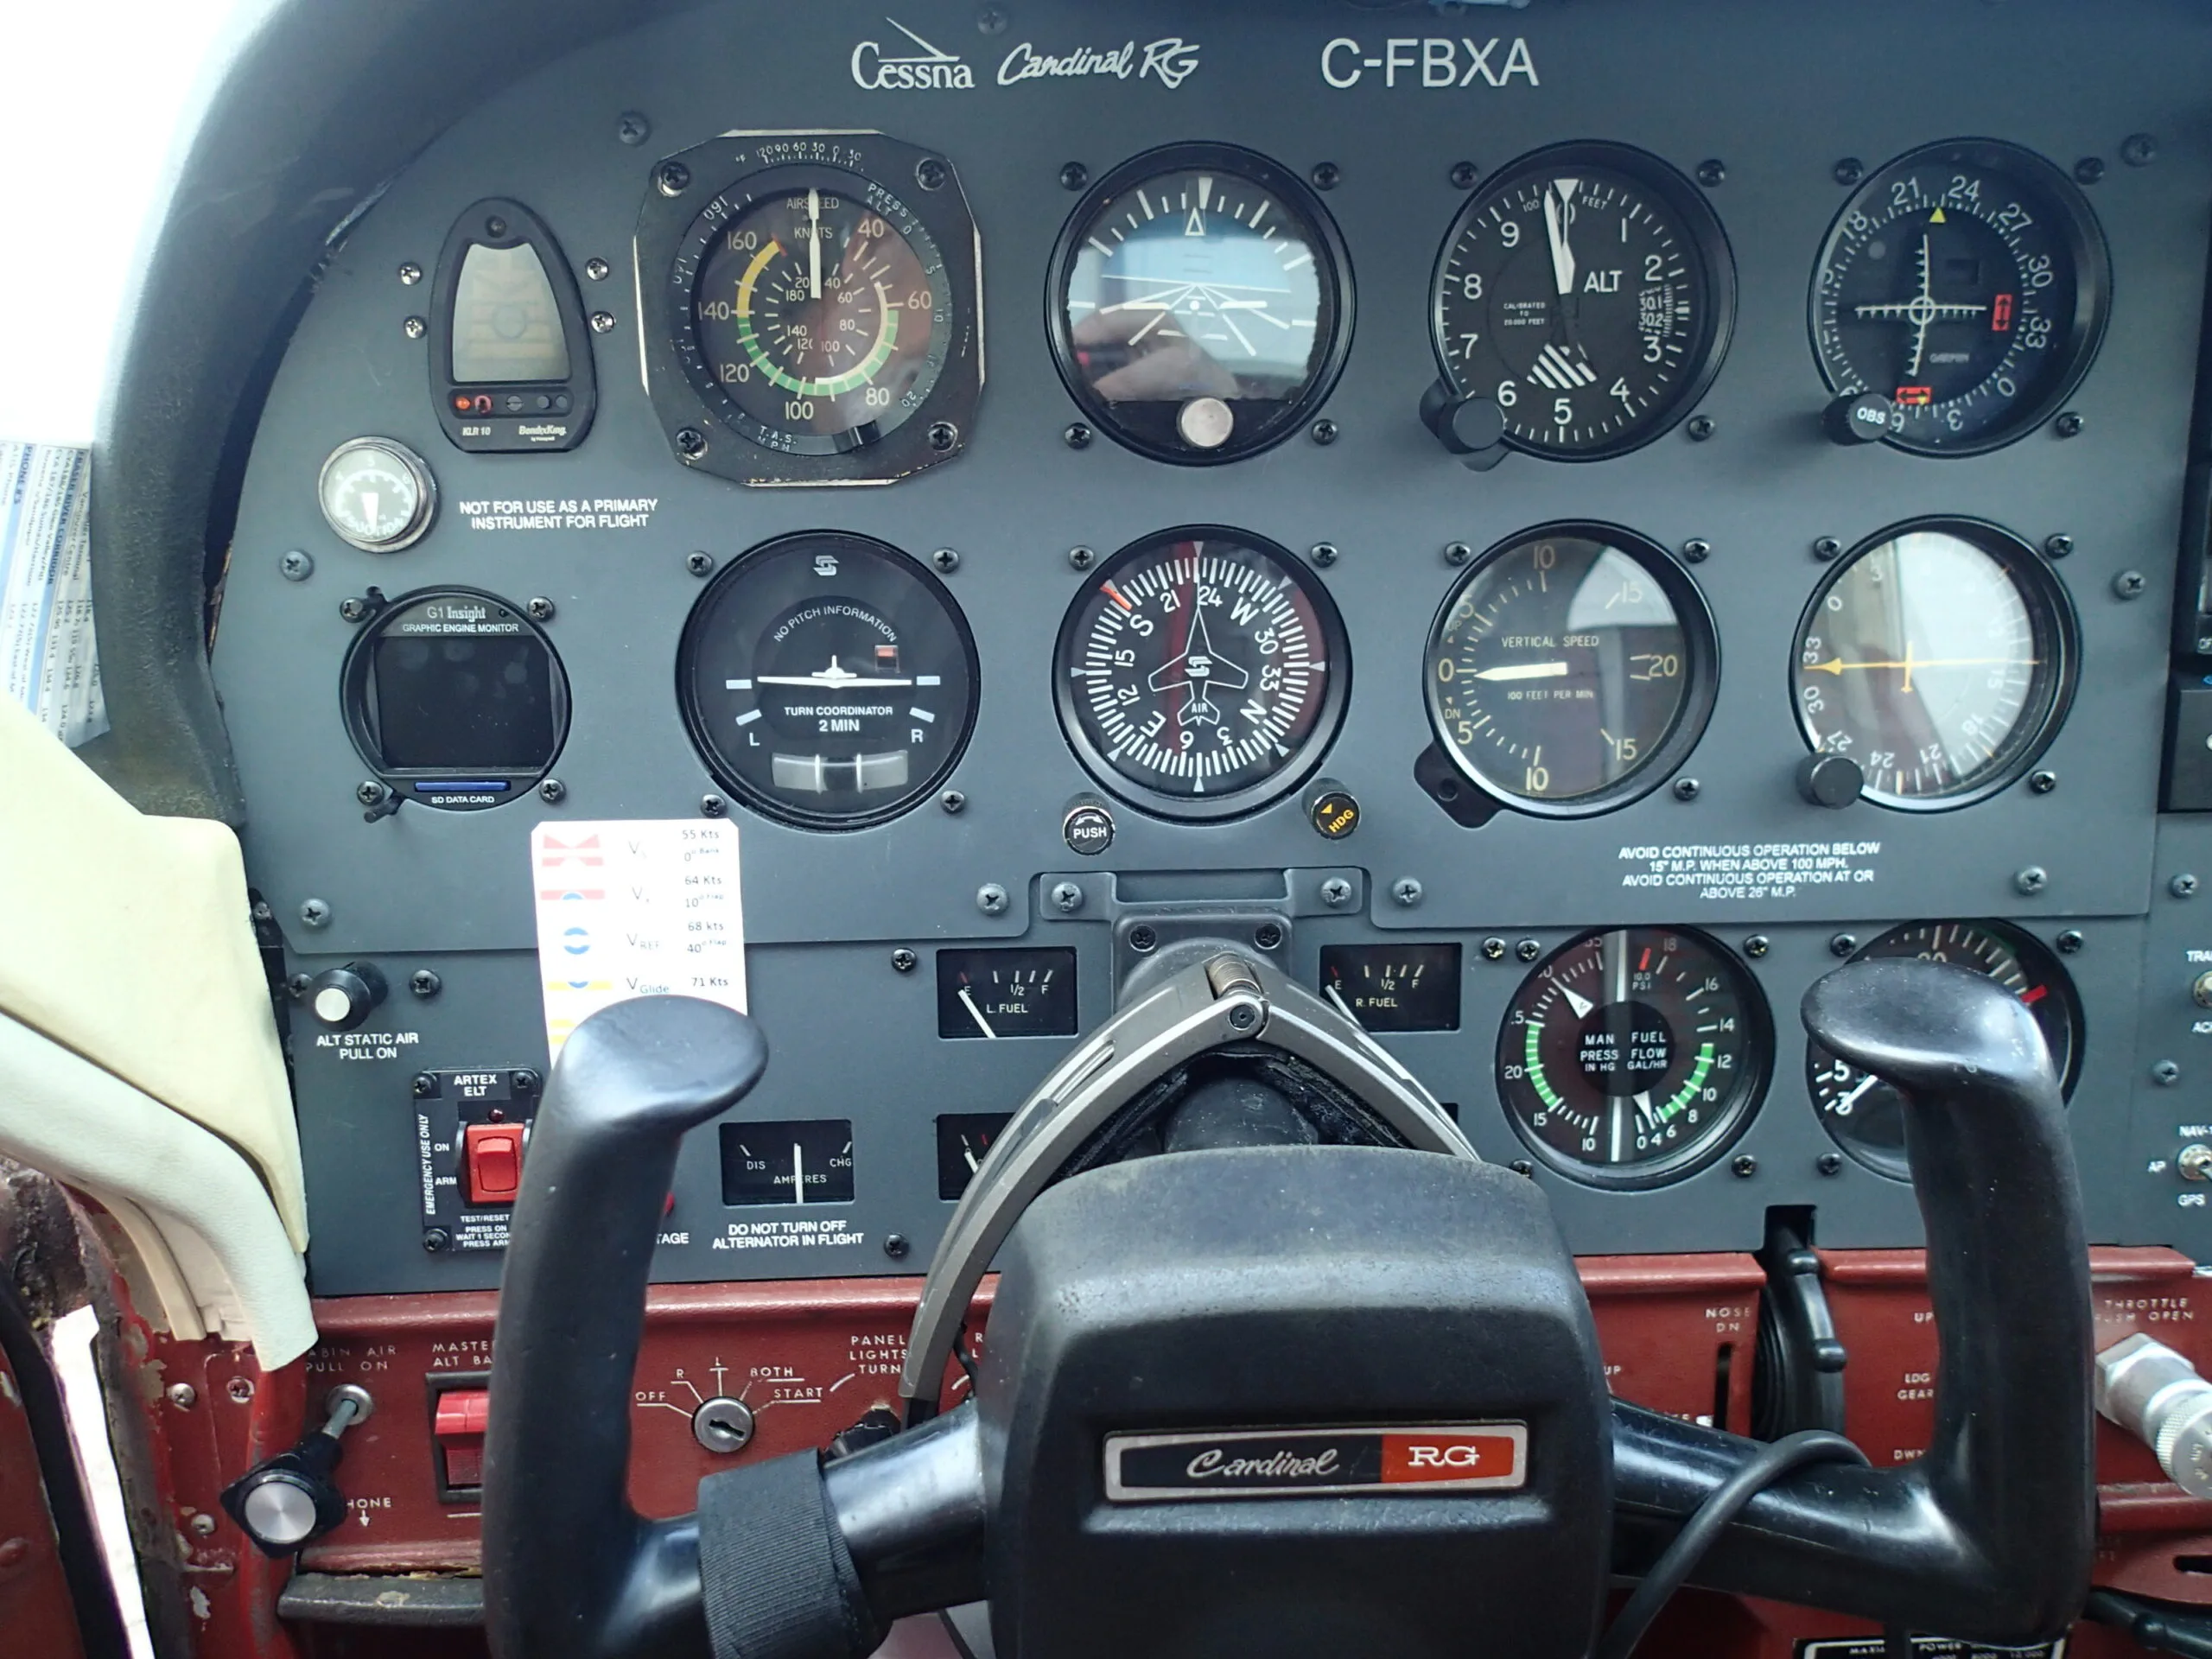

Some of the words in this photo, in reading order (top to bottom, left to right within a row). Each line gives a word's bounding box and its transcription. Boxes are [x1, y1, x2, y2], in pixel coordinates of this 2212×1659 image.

[851, 41, 976, 89] Cessna
[996, 37, 1135, 88] Cardinal
[1141, 39, 1199, 88] RG
[1320, 38, 1540, 88] C-FBXA
[1891, 177, 1920, 205] 21
[1948, 176, 1980, 201] 24
[1582, 195, 1607, 211] FEET
[857, 219, 883, 237] 40
[1501, 221, 1519, 247] 9
[728, 232, 756, 250] 160
[1645, 255, 1662, 281] 2
[2029, 256, 2053, 288] 30
[1464, 273, 1482, 299] 8
[1584, 270, 1623, 292] ALT
[908, 292, 931, 309] 60
[698, 302, 729, 320] 140
[1460, 334, 1478, 359] 7
[1644, 336, 1661, 362] 3
[720, 365, 748, 382] 120
[866, 387, 889, 405] 80
[1498, 380, 1516, 406] 6
[1610, 377, 1630, 403] 4
[785, 401, 813, 420] 100
[1554, 398, 1572, 424] 5
[1857, 407, 1885, 424] OBS
[460, 501, 490, 515] NOT
[494, 500, 522, 514] FOR
[524, 500, 555, 513] USE
[558, 499, 578, 513] AS
[581, 499, 591, 512] A
[595, 499, 658, 512] PRIMARY
[471, 516, 563, 530] INSTRUMENT
[567, 516, 595, 528] FOR
[600, 514, 649, 527] FLIGHT
[1160, 590, 1180, 613] 21
[1198, 587, 1223, 607] 24
[427, 608, 444, 618] G1
[448, 607, 486, 622] Insight
[1230, 598, 1259, 626] W
[403, 624, 442, 632] GRAPHIC
[774, 626, 790, 642] NO
[788, 607, 821, 628] PITCH
[823, 606, 898, 642] INFORMATION
[1130, 614, 1154, 636] S
[1255, 628, 1279, 654] 30
[1502, 637, 1555, 648] VERTICAL
[1563, 637, 1599, 646] SPEED
[1115, 650, 1135, 666] 15
[1649, 656, 1677, 677] 20
[785, 707, 814, 715] TURN
[817, 707, 893, 715] COORDINATOR
[1192, 703, 1208, 713] AIR
[1240, 699, 1267, 724] N
[819, 721, 828, 731] 2
[831, 721, 860, 732] MIN
[1140, 711, 1166, 738] E
[749, 734, 760, 746] L
[911, 729, 923, 742] R
[1616, 739, 1637, 760] 15
[1526, 767, 1548, 791] 10
[1329, 810, 1354, 832] HDG
[1073, 827, 1107, 839] PUSH
[1618, 847, 1658, 859] AVOID
[1662, 846, 1749, 858] CONTINUOUS
[1753, 844, 1829, 856] OPERATION
[1833, 842, 1880, 855] BELOW
[1671, 861, 1697, 871] M.P.
[1700, 860, 1740, 870] WHEN
[1742, 859, 1787, 870] ABOVE
[1792, 858, 1812, 869] 100
[1815, 858, 1848, 869] MPH.
[685, 876, 698, 885] 64
[704, 876, 721, 885] Kts
[1622, 874, 1662, 887] AVOID
[1666, 874, 1752, 885] CONTINUOUS
[1757, 872, 1832, 883] OPERATION
[1834, 871, 1850, 882] AT
[1853, 870, 1873, 881] OR
[1700, 887, 1745, 899] ABOVE
[1771, 887, 1796, 898] M.P.
[688, 922, 702, 931] 68
[707, 922, 723, 931] kts
[640, 984, 669, 994] Glide
[1705, 979, 1718, 991] 16
[1000, 1004, 1028, 1014] FUEL
[1370, 997, 1397, 1007] FUEL
[317, 1035, 340, 1046] ALT
[345, 1034, 392, 1045] STATIC
[396, 1033, 418, 1044] AIR
[1586, 1035, 1615, 1045] MAN
[1631, 1032, 1667, 1043] FUEL
[340, 1048, 373, 1058] PULL
[376, 1048, 397, 1058] ON
[1580, 1051, 1618, 1060] PRESS
[1631, 1048, 1667, 1058] FLOW
[1504, 1066, 1522, 1078] 20
[1586, 1063, 1596, 1071] IN
[1627, 1059, 1667, 1070] GAL/HR
[454, 1075, 497, 1085] ARTEX
[464, 1087, 486, 1096] ELT
[419, 1114, 429, 1138] ONLY
[421, 1140, 431, 1160] USE
[747, 1161, 766, 1170] DIS
[830, 1158, 851, 1167] CHG
[2148, 1161, 2165, 1173] AP
[421, 1161, 435, 1215] EMERGENCY
[2178, 1195, 2205, 1206] GPS
[461, 1214, 509, 1223] TEST/RESET
[729, 1224, 748, 1235] DO
[752, 1223, 779, 1233] NOT
[781, 1222, 817, 1232] TURN
[820, 1220, 847, 1230] OFF
[712, 1236, 798, 1249] ALTERNATOR
[802, 1235, 816, 1246] IN
[817, 1233, 863, 1244] FLIGHT
[2105, 1299, 2188, 1308] THROTTLE
[1706, 1307, 1751, 1318] NOSE
[2148, 1311, 2194, 1320] OPEN
[1716, 1323, 1739, 1332] DN
[851, 1336, 906, 1345] PANEL
[367, 1345, 396, 1355] AIR
[360, 1361, 387, 1370] ON
[434, 1357, 459, 1367] ALT
[859, 1363, 900, 1374] TURN
[750, 1367, 793, 1376] BOTH
[1905, 1373, 1930, 1383] LDG
[636, 1392, 666, 1402] OFF
[774, 1387, 823, 1398] START
[1897, 1389, 1934, 1400] GEAR
[1186, 1448, 1340, 1478] Cardinal
[1408, 1446, 1479, 1465] RG
